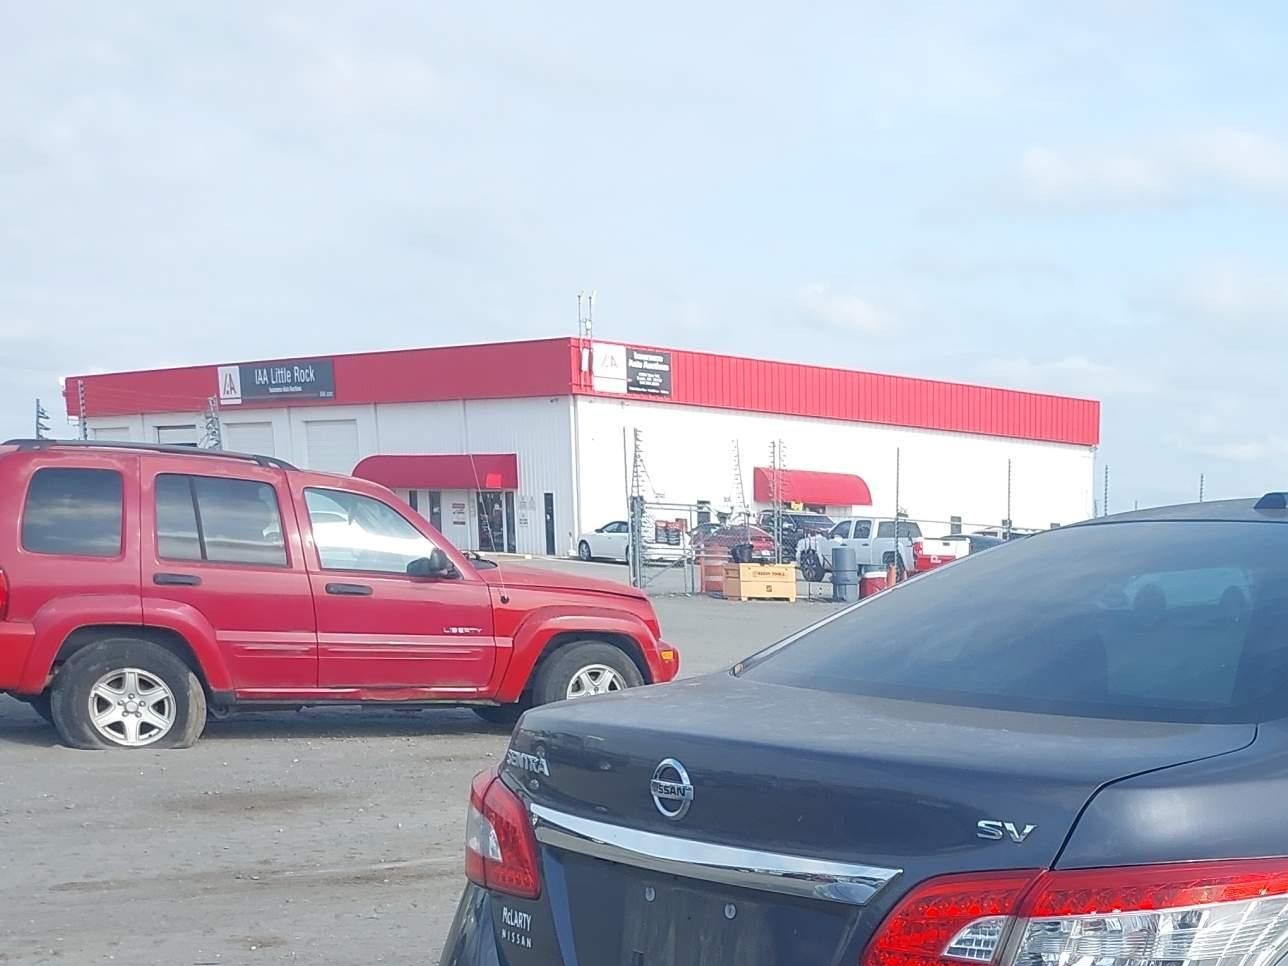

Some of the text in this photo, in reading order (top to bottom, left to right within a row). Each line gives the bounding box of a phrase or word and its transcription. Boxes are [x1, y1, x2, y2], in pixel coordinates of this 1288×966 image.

[255, 365, 316, 385] IAA Little Rock
[507, 749, 550, 777] SENTRA
[653, 783, 686, 797] SSAN
[977, 820, 1038, 842] SV
[502, 906, 532, 932] McLARTY
[502, 928, 532, 949] NISSAN
